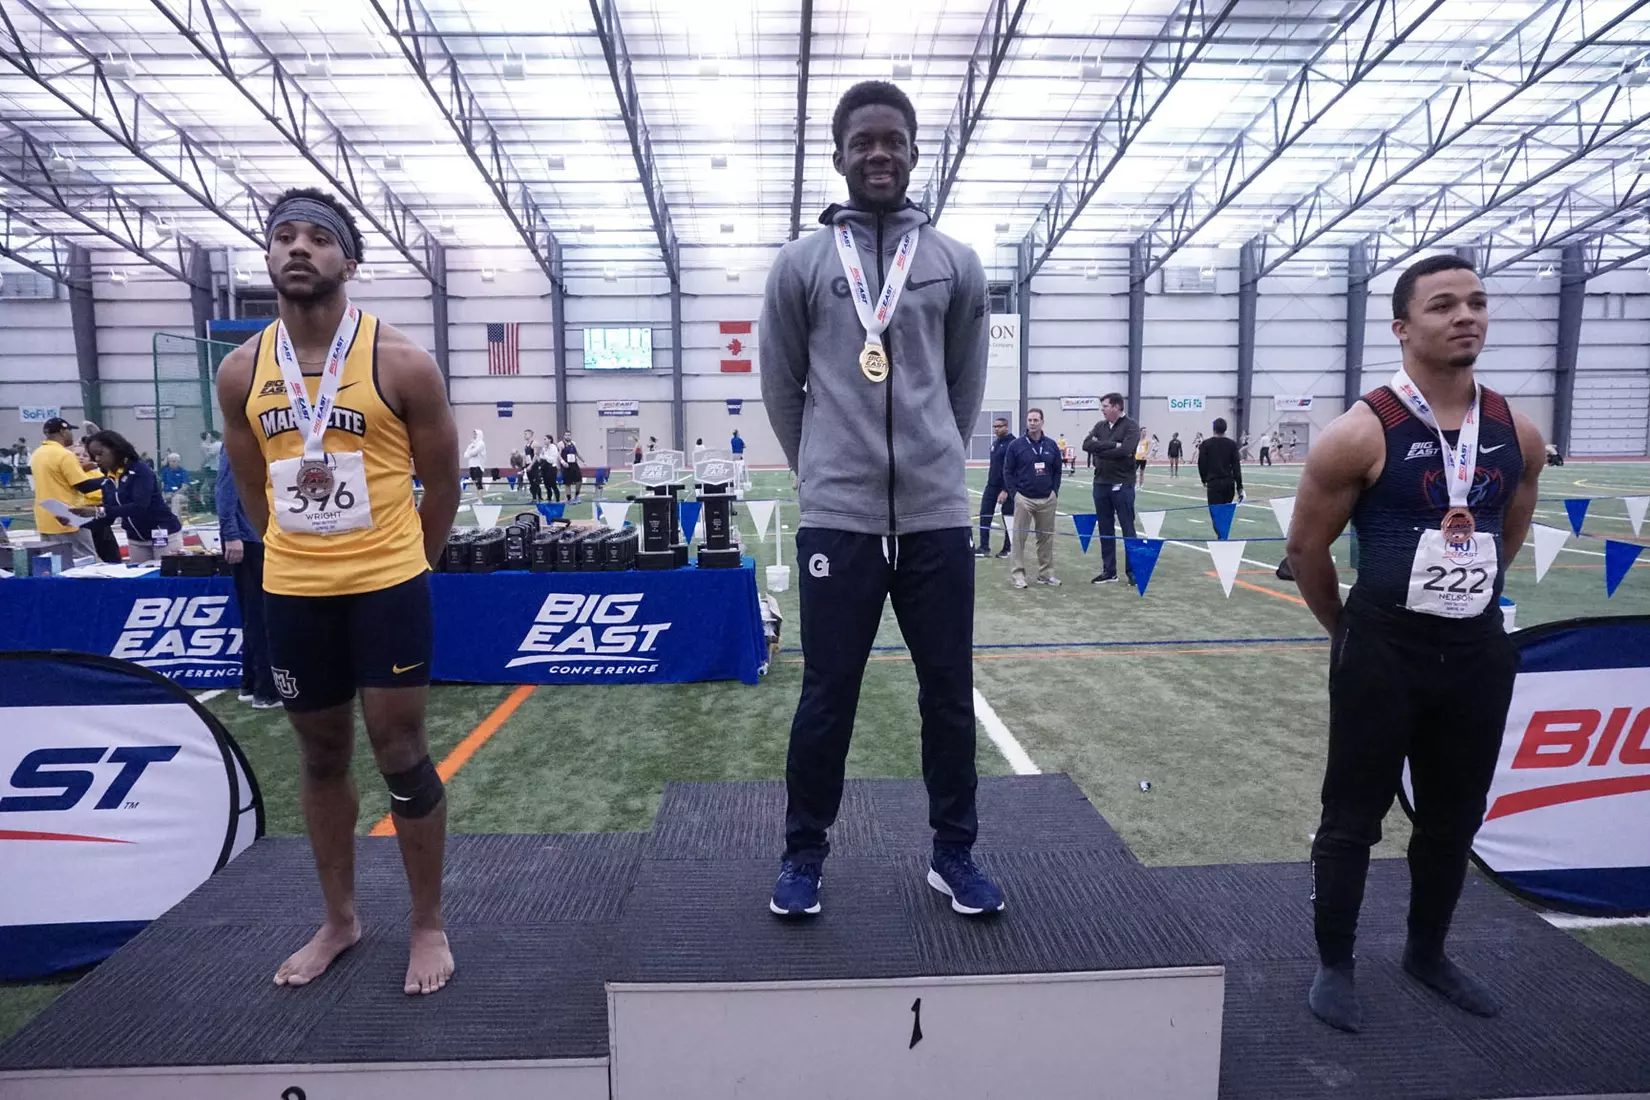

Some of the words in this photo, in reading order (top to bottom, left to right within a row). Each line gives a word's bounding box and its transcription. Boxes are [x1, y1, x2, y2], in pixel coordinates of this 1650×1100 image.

[882, 284, 893, 307] EAST
[333, 336, 343, 358] EAST
[23, 409, 45, 419] SoFi
[1171, 399, 1191, 408] SoFi
[259, 407, 365, 438] MARTTE
[1407, 448, 1440, 456] EAST
[1411, 441, 1434, 449] BIG
[1460, 443, 1468, 465] EAST
[305, 511, 342, 520] WRIGHT
[809, 553, 830, 577] G
[1423, 565, 1488, 593] 222
[534, 593, 644, 624] BIG
[1438, 594, 1473, 602] NELSON
[123, 595, 229, 629] BIG
[517, 622, 672, 653] EAST
[157, 668, 243, 679] NFERENCE
[549, 664, 659, 675] CONFERENCE
[909, 998, 923, 1050] 1
